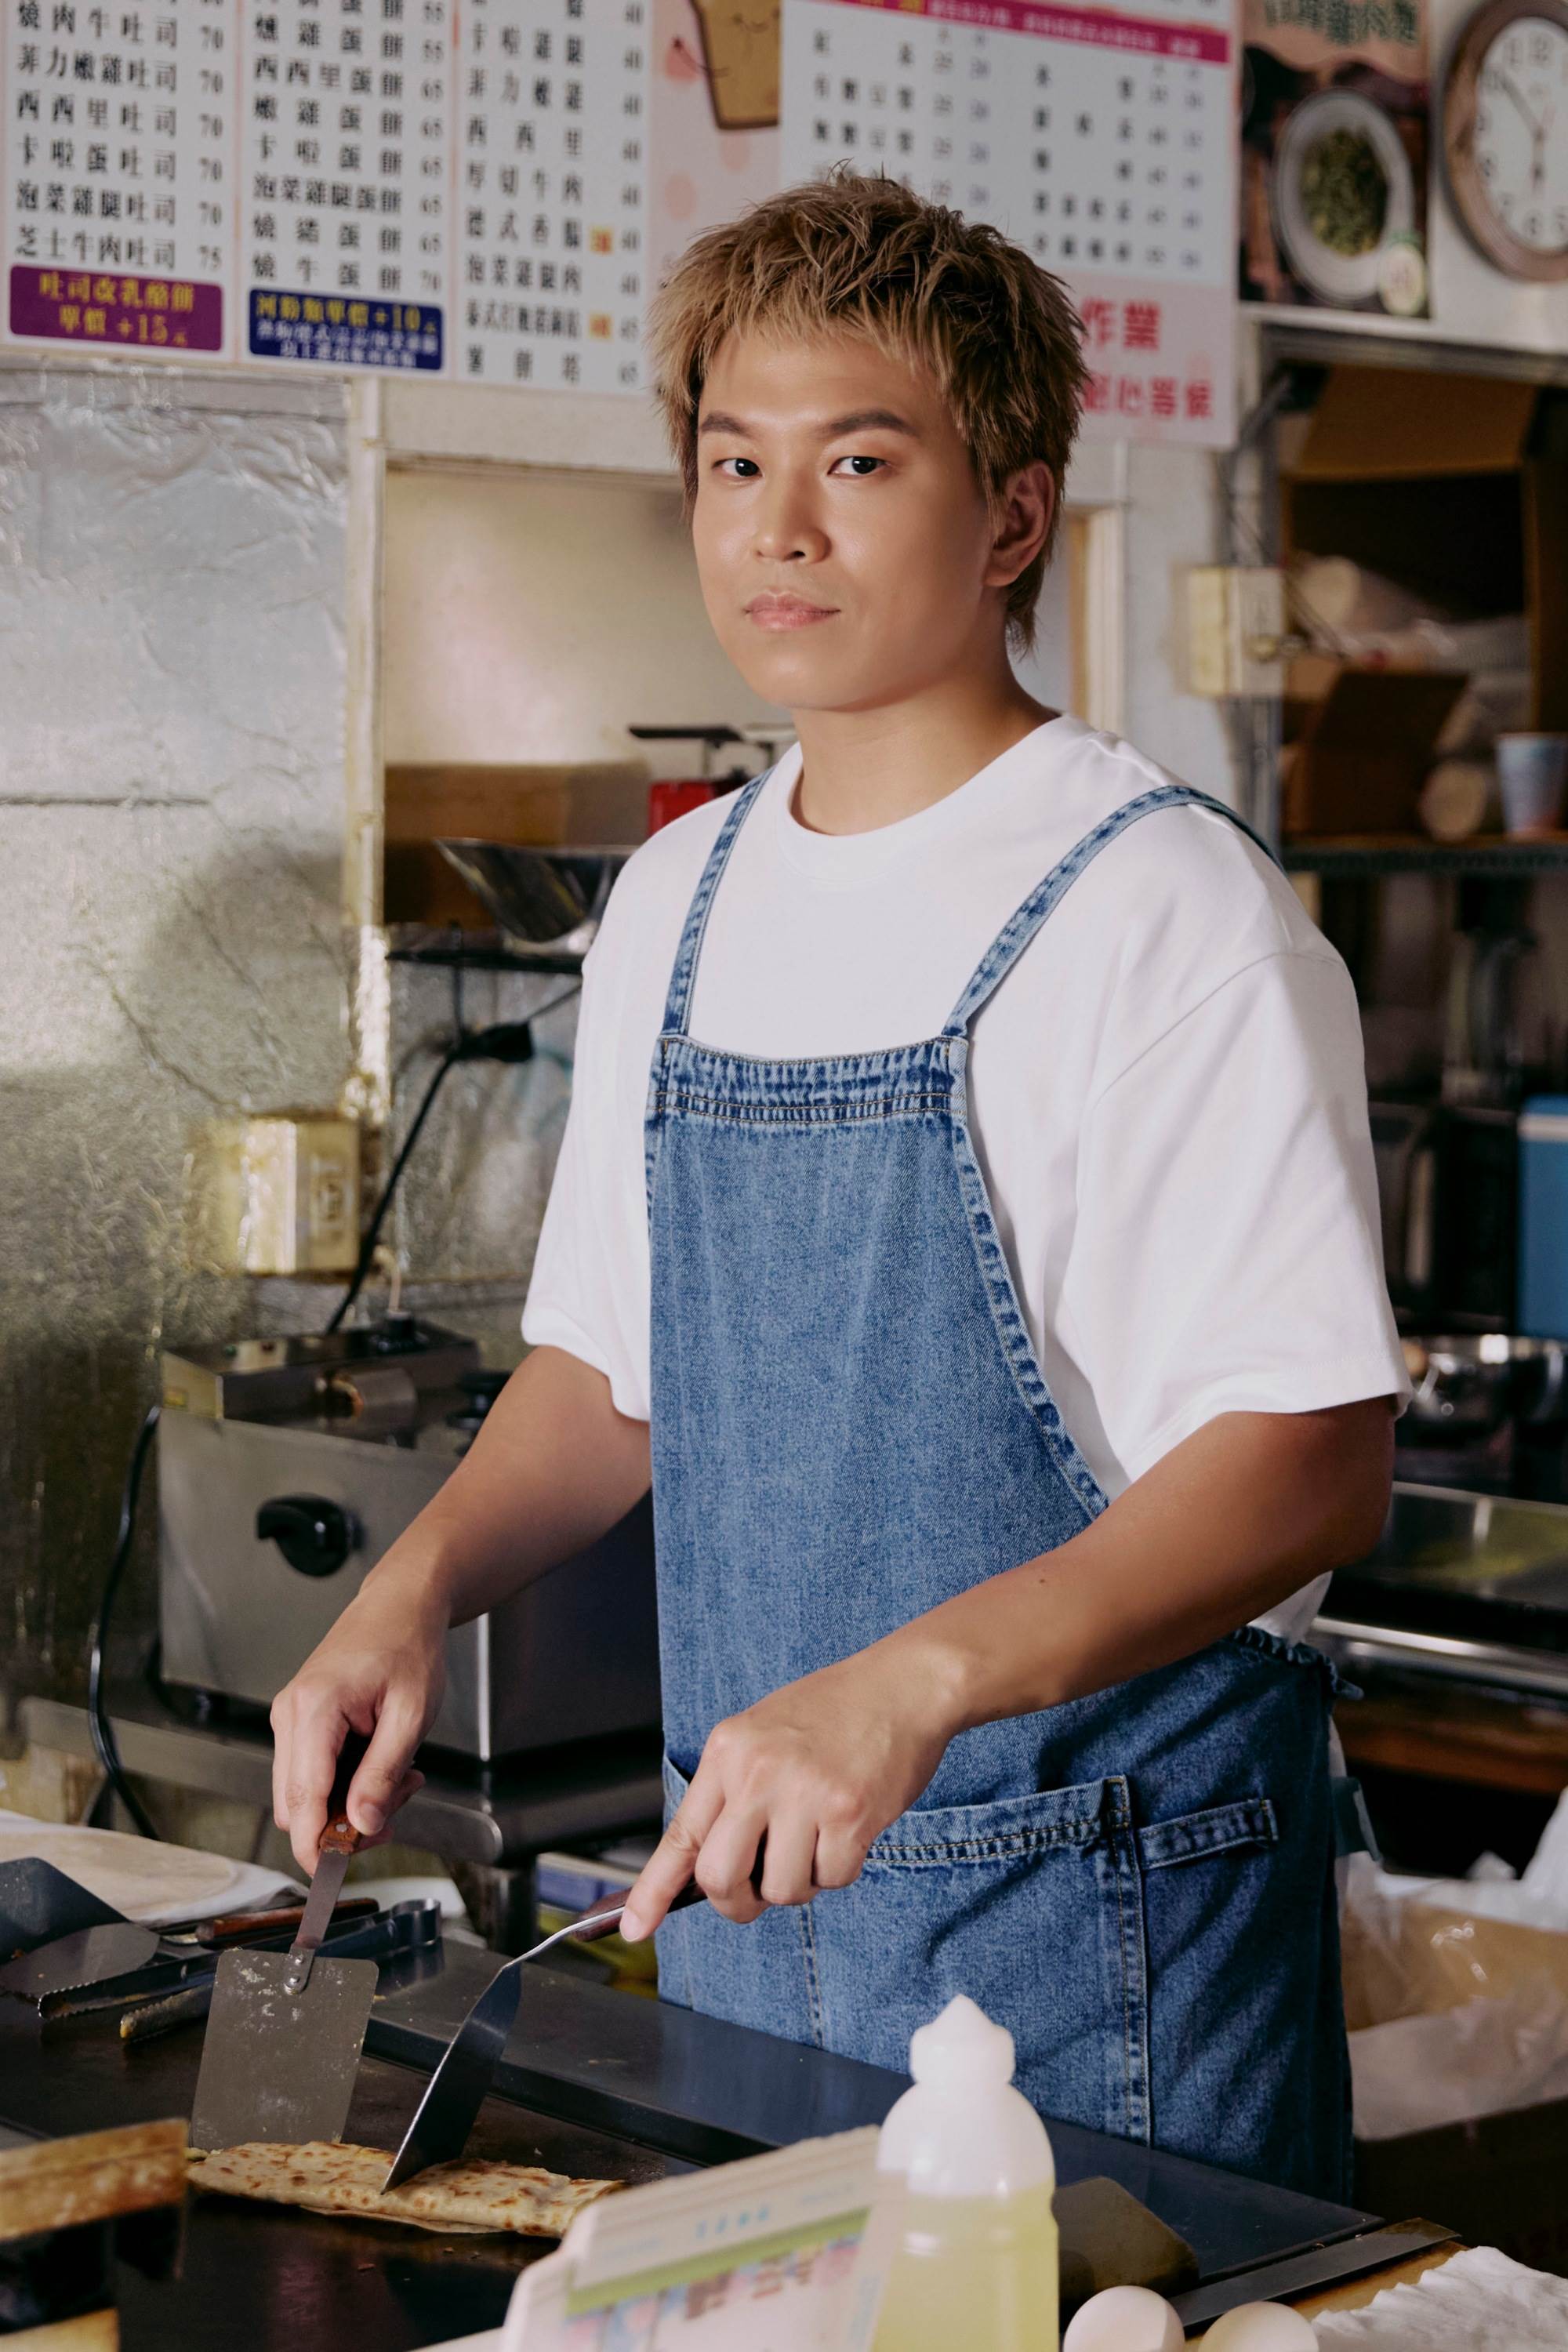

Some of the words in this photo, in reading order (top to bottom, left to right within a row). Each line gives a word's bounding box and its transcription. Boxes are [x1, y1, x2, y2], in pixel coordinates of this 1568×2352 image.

[201, 27, 223, 49] 70
[200, 71, 223, 93] 70
[200, 114, 223, 138] 70
[200, 158, 223, 183] 70
[200, 201, 223, 226] 70
[199, 245, 222, 270] 75
